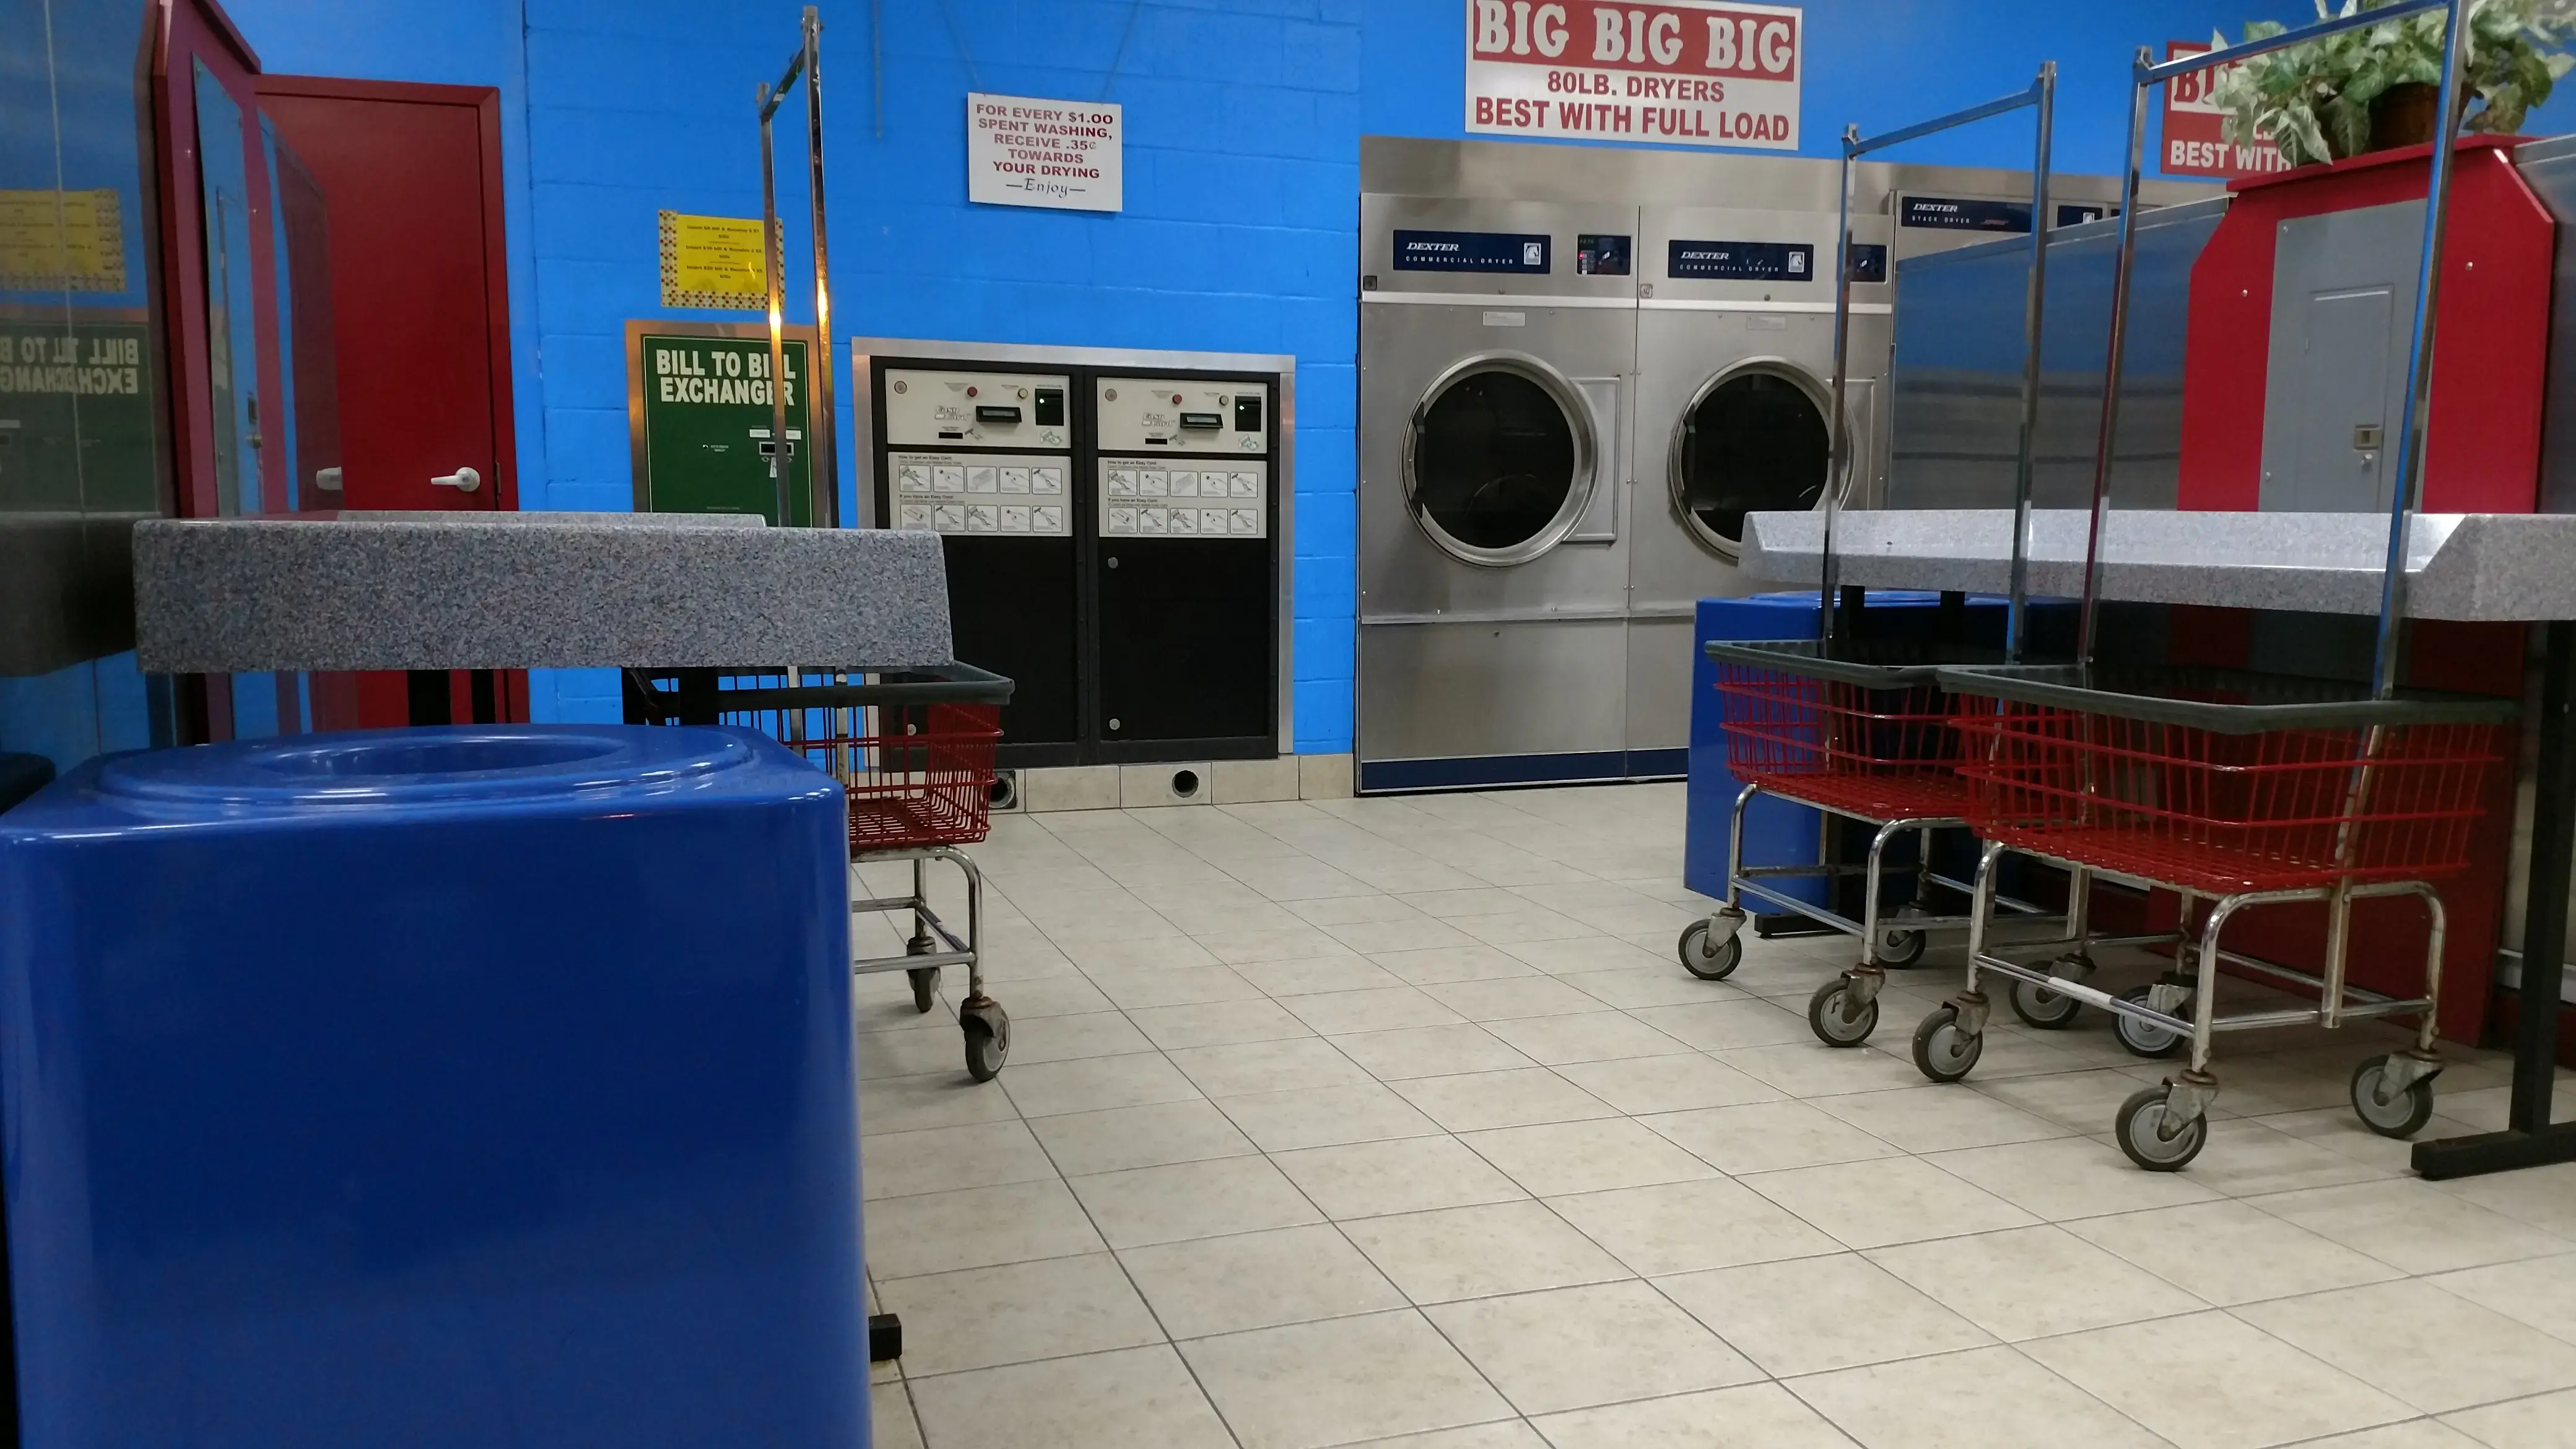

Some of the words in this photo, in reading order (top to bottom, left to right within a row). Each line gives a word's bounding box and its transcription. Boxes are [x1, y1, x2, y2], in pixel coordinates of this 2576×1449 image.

[1476, 0, 1569, 58] BIG
[1593, 7, 1683, 64] BIG
[1705, 16, 1792, 73] BIG
[1547, 71, 1617, 95] 80LB.
[1627, 76, 1725, 102] DRYERS
[977, 103, 1007, 116] FOR
[1012, 107, 1063, 121] EVERY
[1068, 112, 1113, 124] $1.00
[1476, 97, 1549, 128] BEST
[1559, 102, 1632, 133] WITH
[1642, 107, 1710, 137] FULL
[1720, 112, 1789, 141] LOAD
[978, 118, 1029, 133] SPENT
[1034, 124, 1112, 141] WASHING,
[994, 133, 1060, 149] RECEIVE
[1008, 149, 1084, 164] TOWARDS
[2171, 140, 2229, 168] BEST
[2235, 145, 2292, 172] WITH
[993, 161, 1035, 175] YOUR
[1041, 165, 1100, 179] DRYING
[1912, 203, 1958, 212] DEXTER
[1406, 242, 1460, 251] DEXTER
[1681, 251, 1729, 260] DEXTER
[1406, 256, 1474, 264] COMMERCIAL
[656, 349, 705, 376] BILL
[711, 351, 741, 377] TO
[748, 352, 796, 379] BIL
